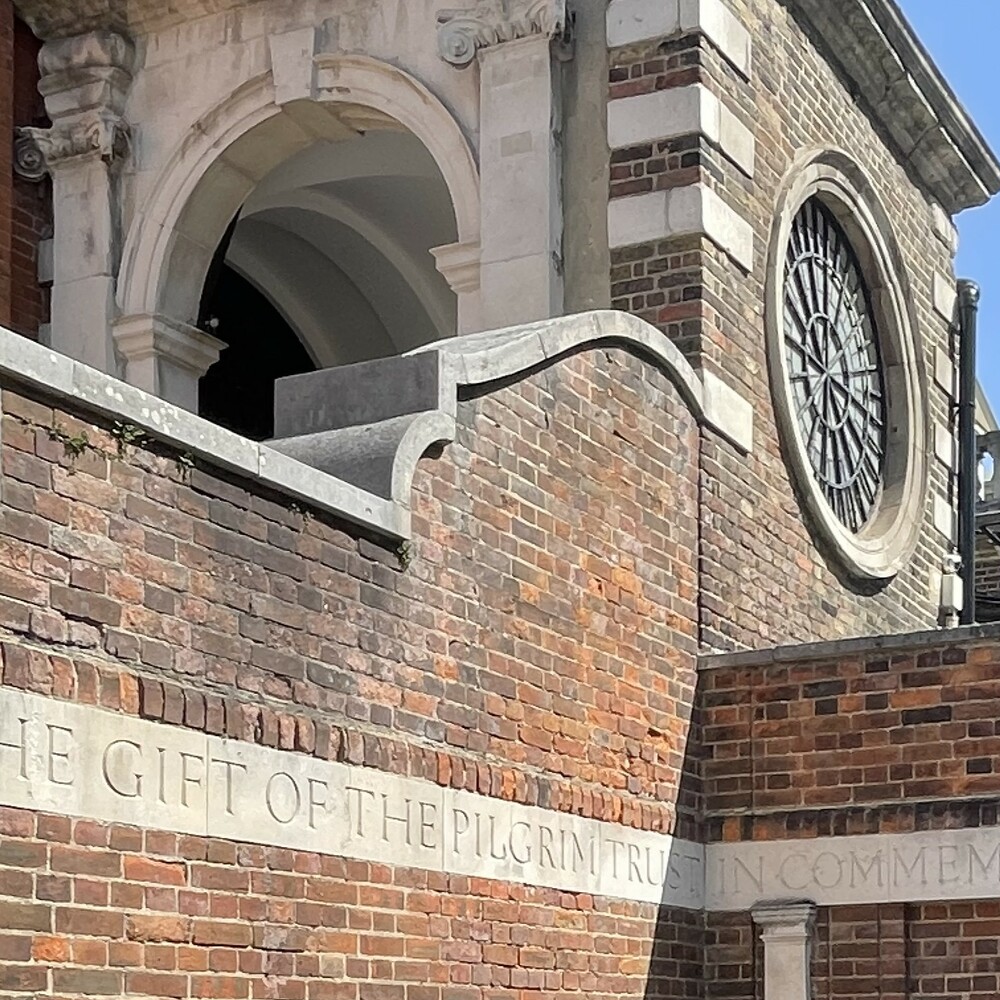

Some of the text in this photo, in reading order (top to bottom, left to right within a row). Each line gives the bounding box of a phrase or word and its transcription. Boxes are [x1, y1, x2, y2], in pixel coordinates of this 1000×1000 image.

[103, 739, 248, 815] GIFT
[265, 771, 328, 829] OF
[345, 785, 438, 849] THE
[453, 807, 598, 876] PILGRIM
[605, 837, 701, 893] TRUST
[718, 856, 763, 894] IN
